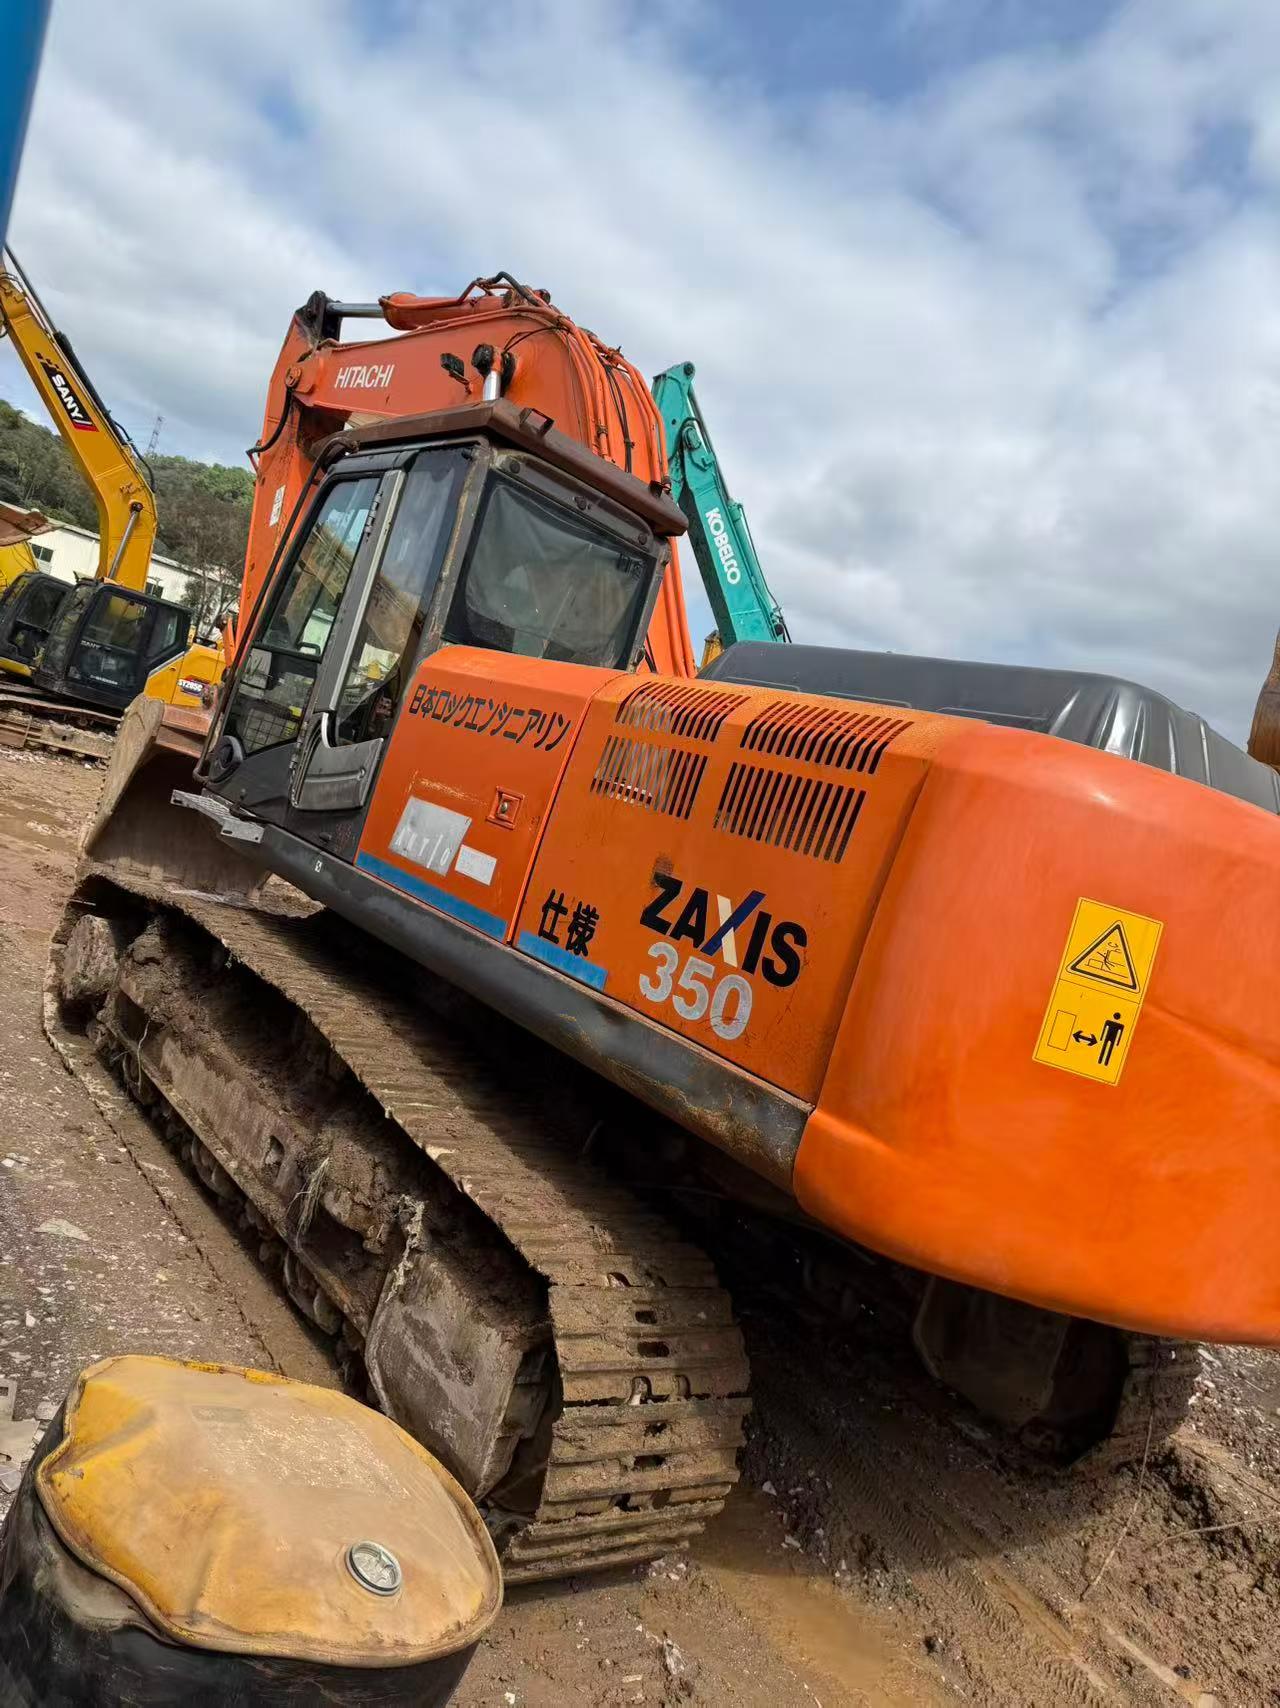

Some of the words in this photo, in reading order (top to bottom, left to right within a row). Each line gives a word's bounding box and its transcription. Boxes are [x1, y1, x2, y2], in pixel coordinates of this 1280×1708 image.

[52, 373, 84, 419] SANY
[333, 364, 396, 388] HITACHI
[705, 507, 741, 585] KOBELCO
[537, 888, 600, 958] 仕様
[639, 871, 808, 988] ZAXIS
[638, 941, 753, 1041] 350
